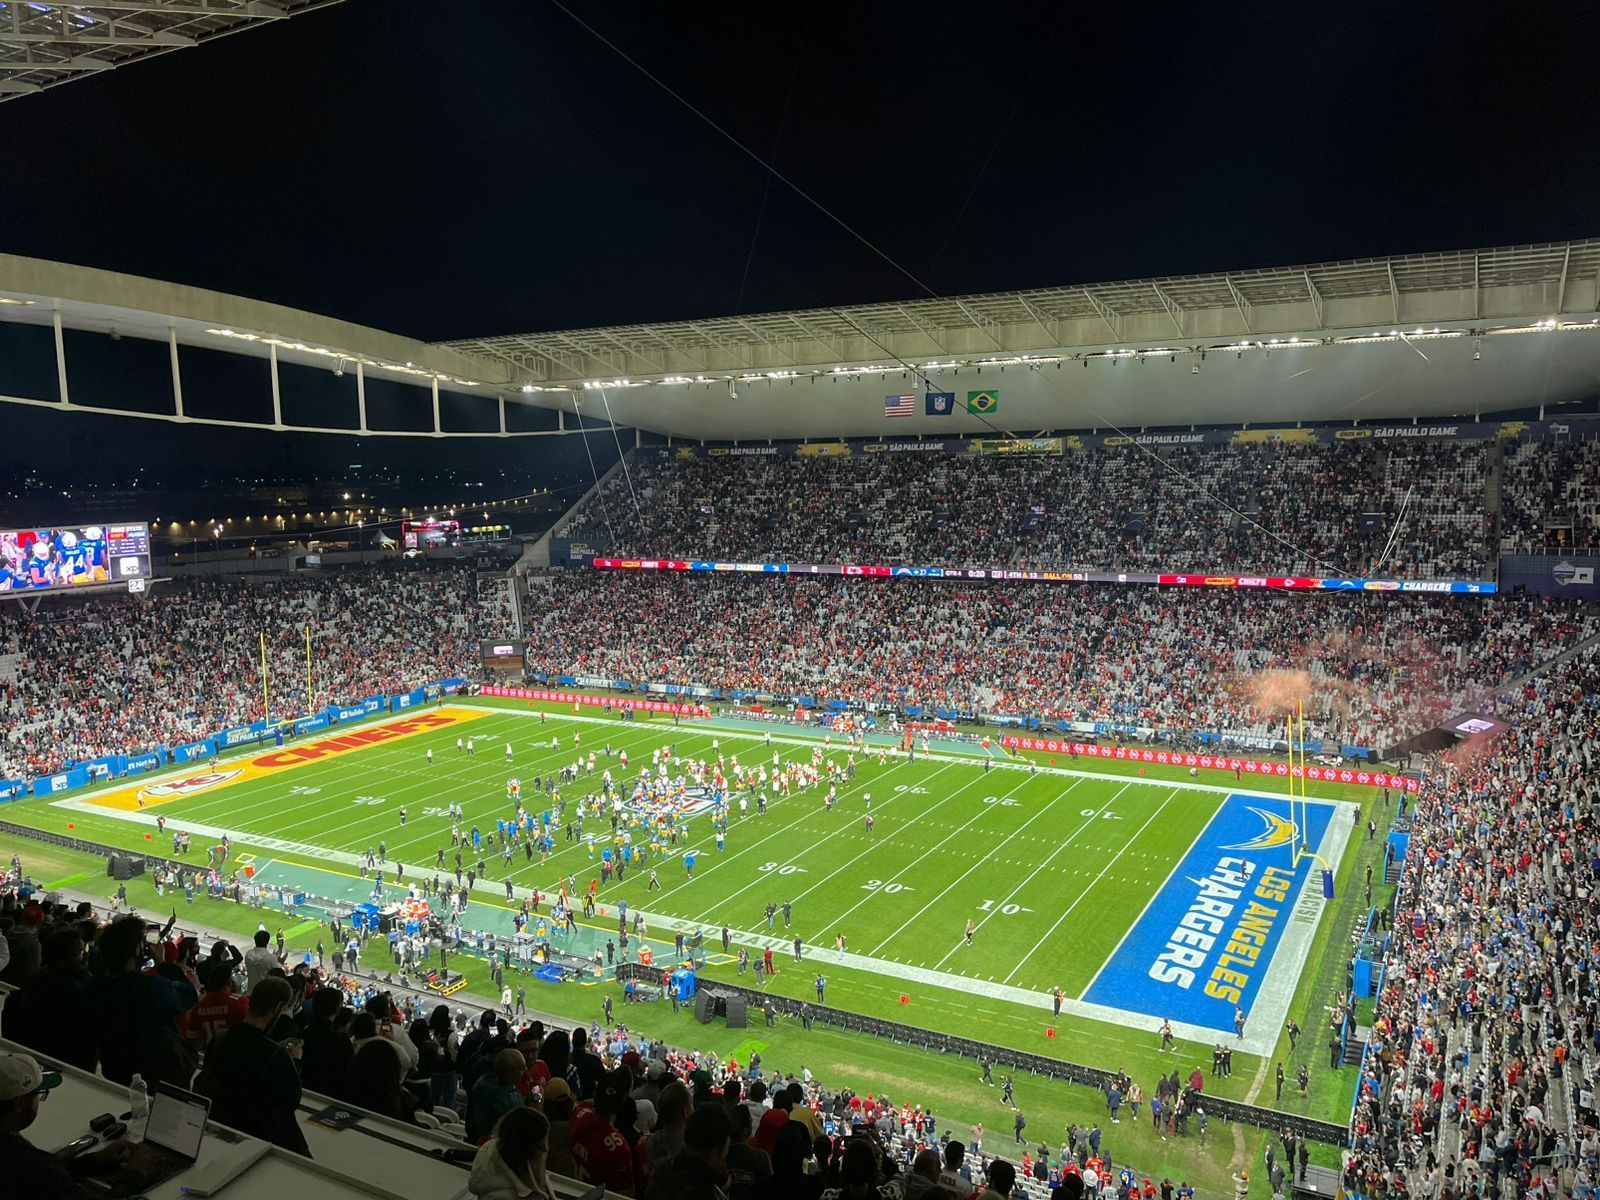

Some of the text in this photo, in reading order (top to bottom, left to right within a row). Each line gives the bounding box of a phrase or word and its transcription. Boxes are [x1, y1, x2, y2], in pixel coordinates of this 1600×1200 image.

[1394, 428, 1427, 437] PAULO
[1429, 426, 1458, 436] GAME
[1153, 435, 1180, 444] PAULO
[1180, 434, 1204, 442] GAME
[903, 443, 924, 451] PAULO
[925, 442, 944, 450] GAME
[67, 553, 84, 571] 44
[968, 570, 985, 578] 0:20
[1403, 582, 1451, 591] CHARGERS
[252, 714, 458, 768] CHIEFS
[758, 862, 799, 875] 30
[861, 879, 904, 893] 20
[976, 900, 1021, 915] 10
[1294, 887, 1324, 924] RACISM
[1149, 856, 1256, 990] CHARGERS
[1204, 866, 1296, 1004] LOS ANGELES
[603, 1132, 623, 1152] 95
